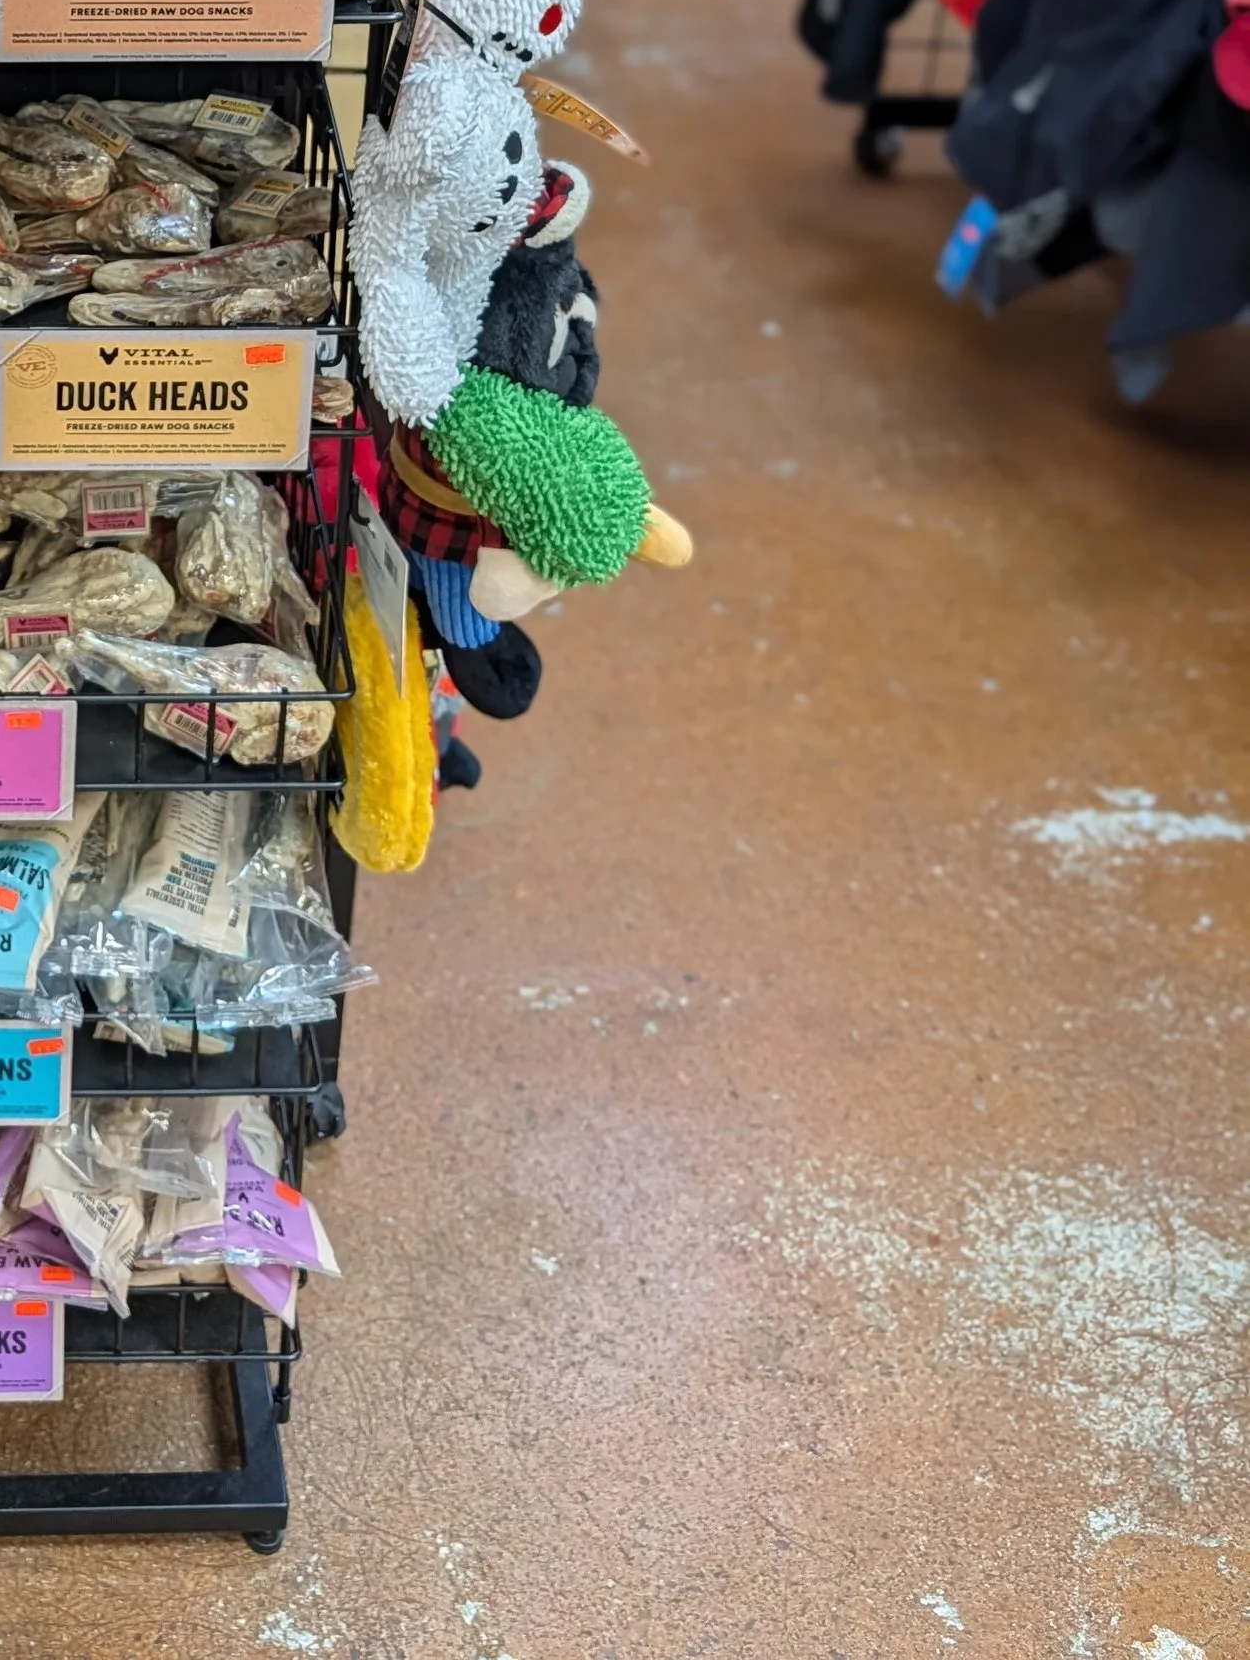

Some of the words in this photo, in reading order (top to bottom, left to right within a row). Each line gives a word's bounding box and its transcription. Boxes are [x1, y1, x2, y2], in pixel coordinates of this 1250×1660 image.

[70, 7, 148, 17] FREEZE-DRIED
[150, 7, 177, 17] RAW
[179, 6, 205, 16] DOG
[207, 6, 254, 16] SNACKS
[123, 348, 194, 357] VITAL
[56, 381, 138, 411] DUCK
[147, 380, 249, 411] HEADS
[65, 422, 138, 431] FREEZE-DRIED
[140, 422, 165, 431] RAW
[166, 422, 191, 431] DOG
[193, 422, 235, 431] SNACKS
[14, 1255, 43, 1269] AW
